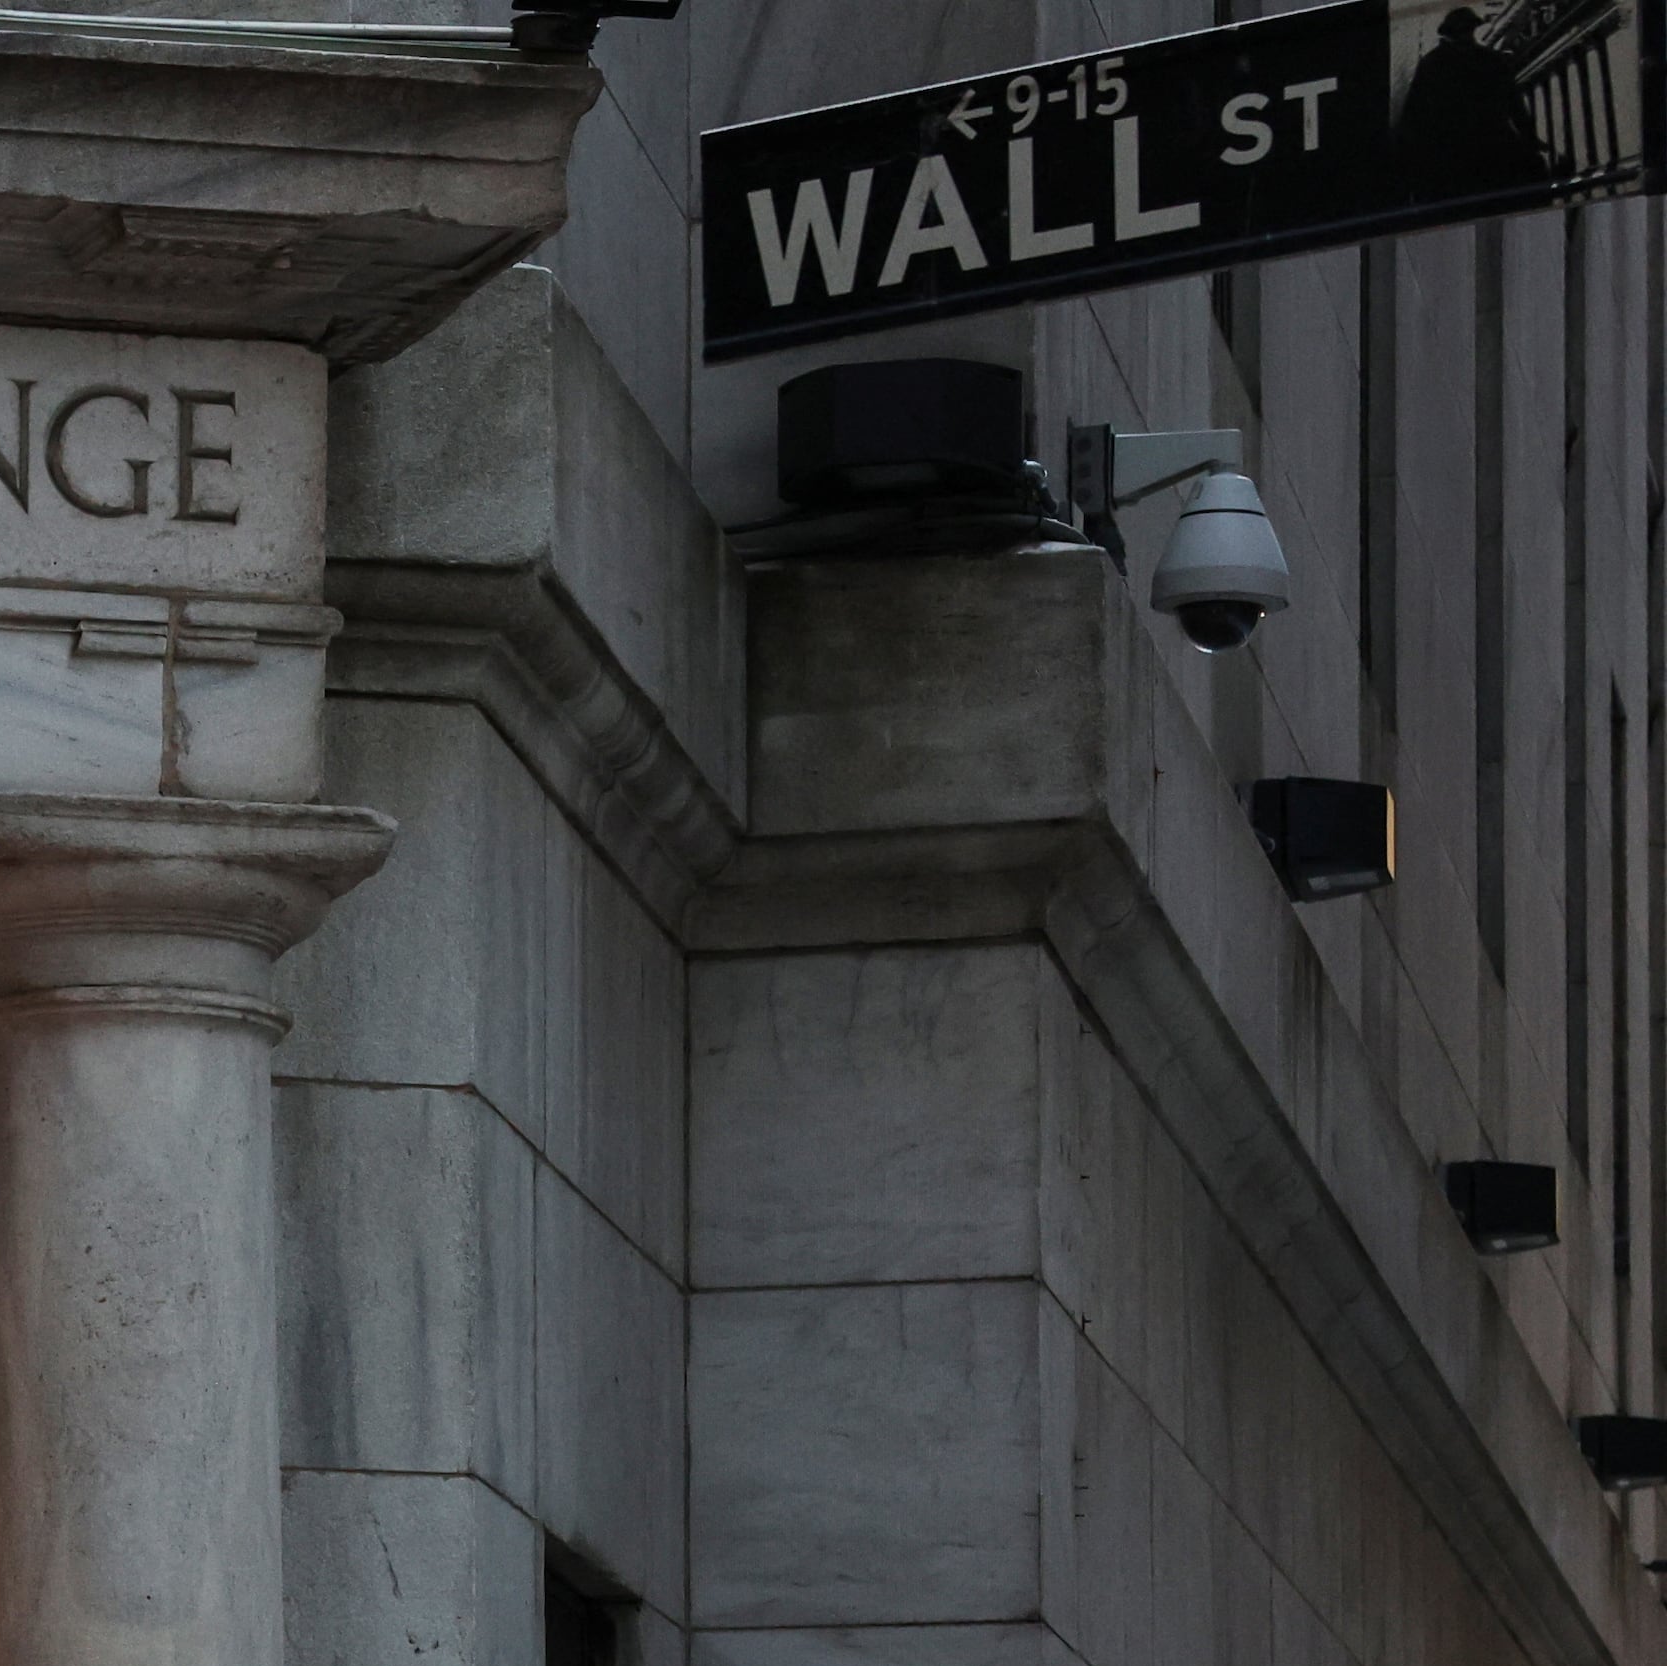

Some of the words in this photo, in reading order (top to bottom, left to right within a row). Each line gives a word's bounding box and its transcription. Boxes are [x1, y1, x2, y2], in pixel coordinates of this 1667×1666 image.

[1005, 57, 1129, 134] 9-15
[747, 117, 1201, 307] WALL
[1219, 76, 1339, 166] ST
